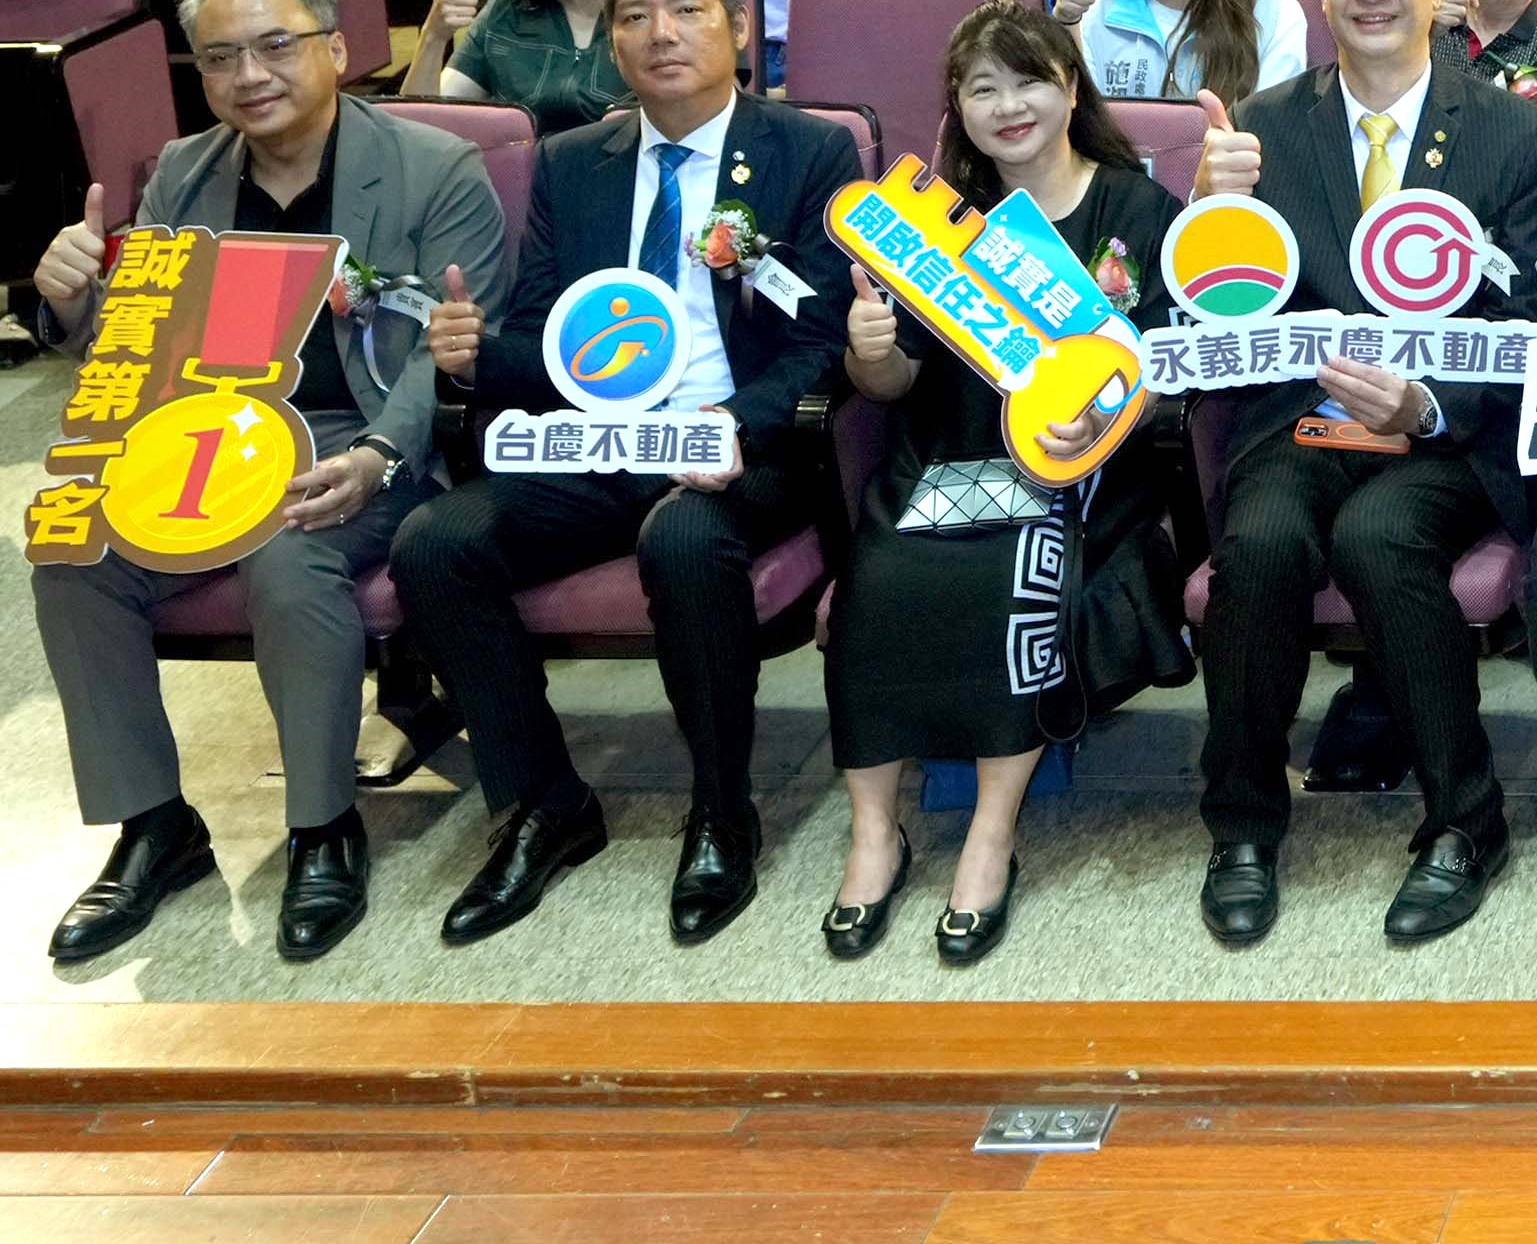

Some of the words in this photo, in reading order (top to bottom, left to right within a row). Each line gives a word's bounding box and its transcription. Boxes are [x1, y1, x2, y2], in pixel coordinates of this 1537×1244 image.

[969, 221, 1083, 329] 誠實是
[28, 230, 196, 547] 誠實第一名
[157, 427, 225, 520] 1
[494, 421, 725, 464] 台慶不動產
